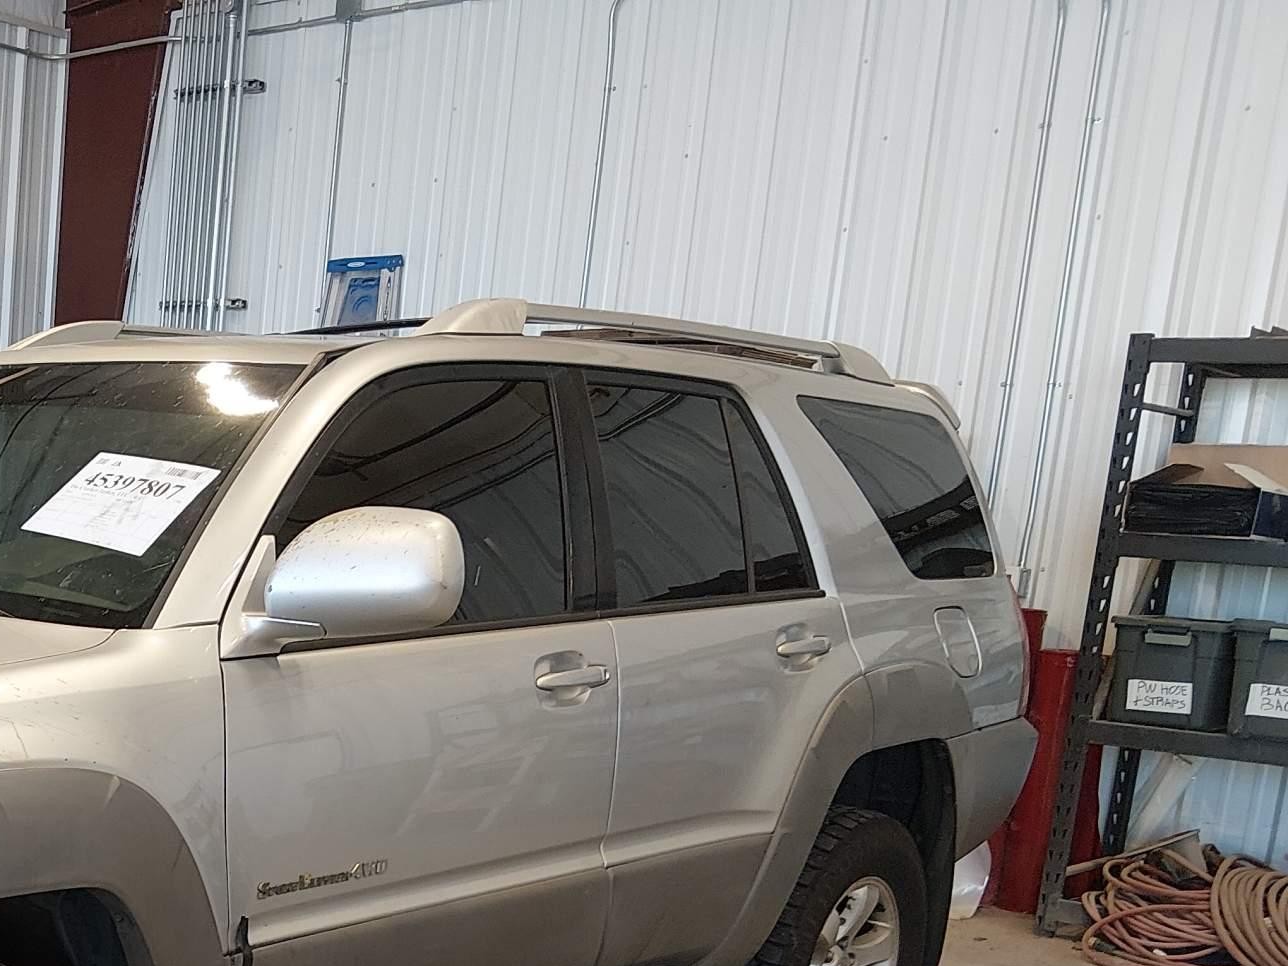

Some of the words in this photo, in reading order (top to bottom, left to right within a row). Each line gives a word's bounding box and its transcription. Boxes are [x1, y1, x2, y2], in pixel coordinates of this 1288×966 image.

[85, 472, 186, 500] 45397807
[1137, 681, 1157, 694] PW
[1161, 684, 1188, 696] HOSE
